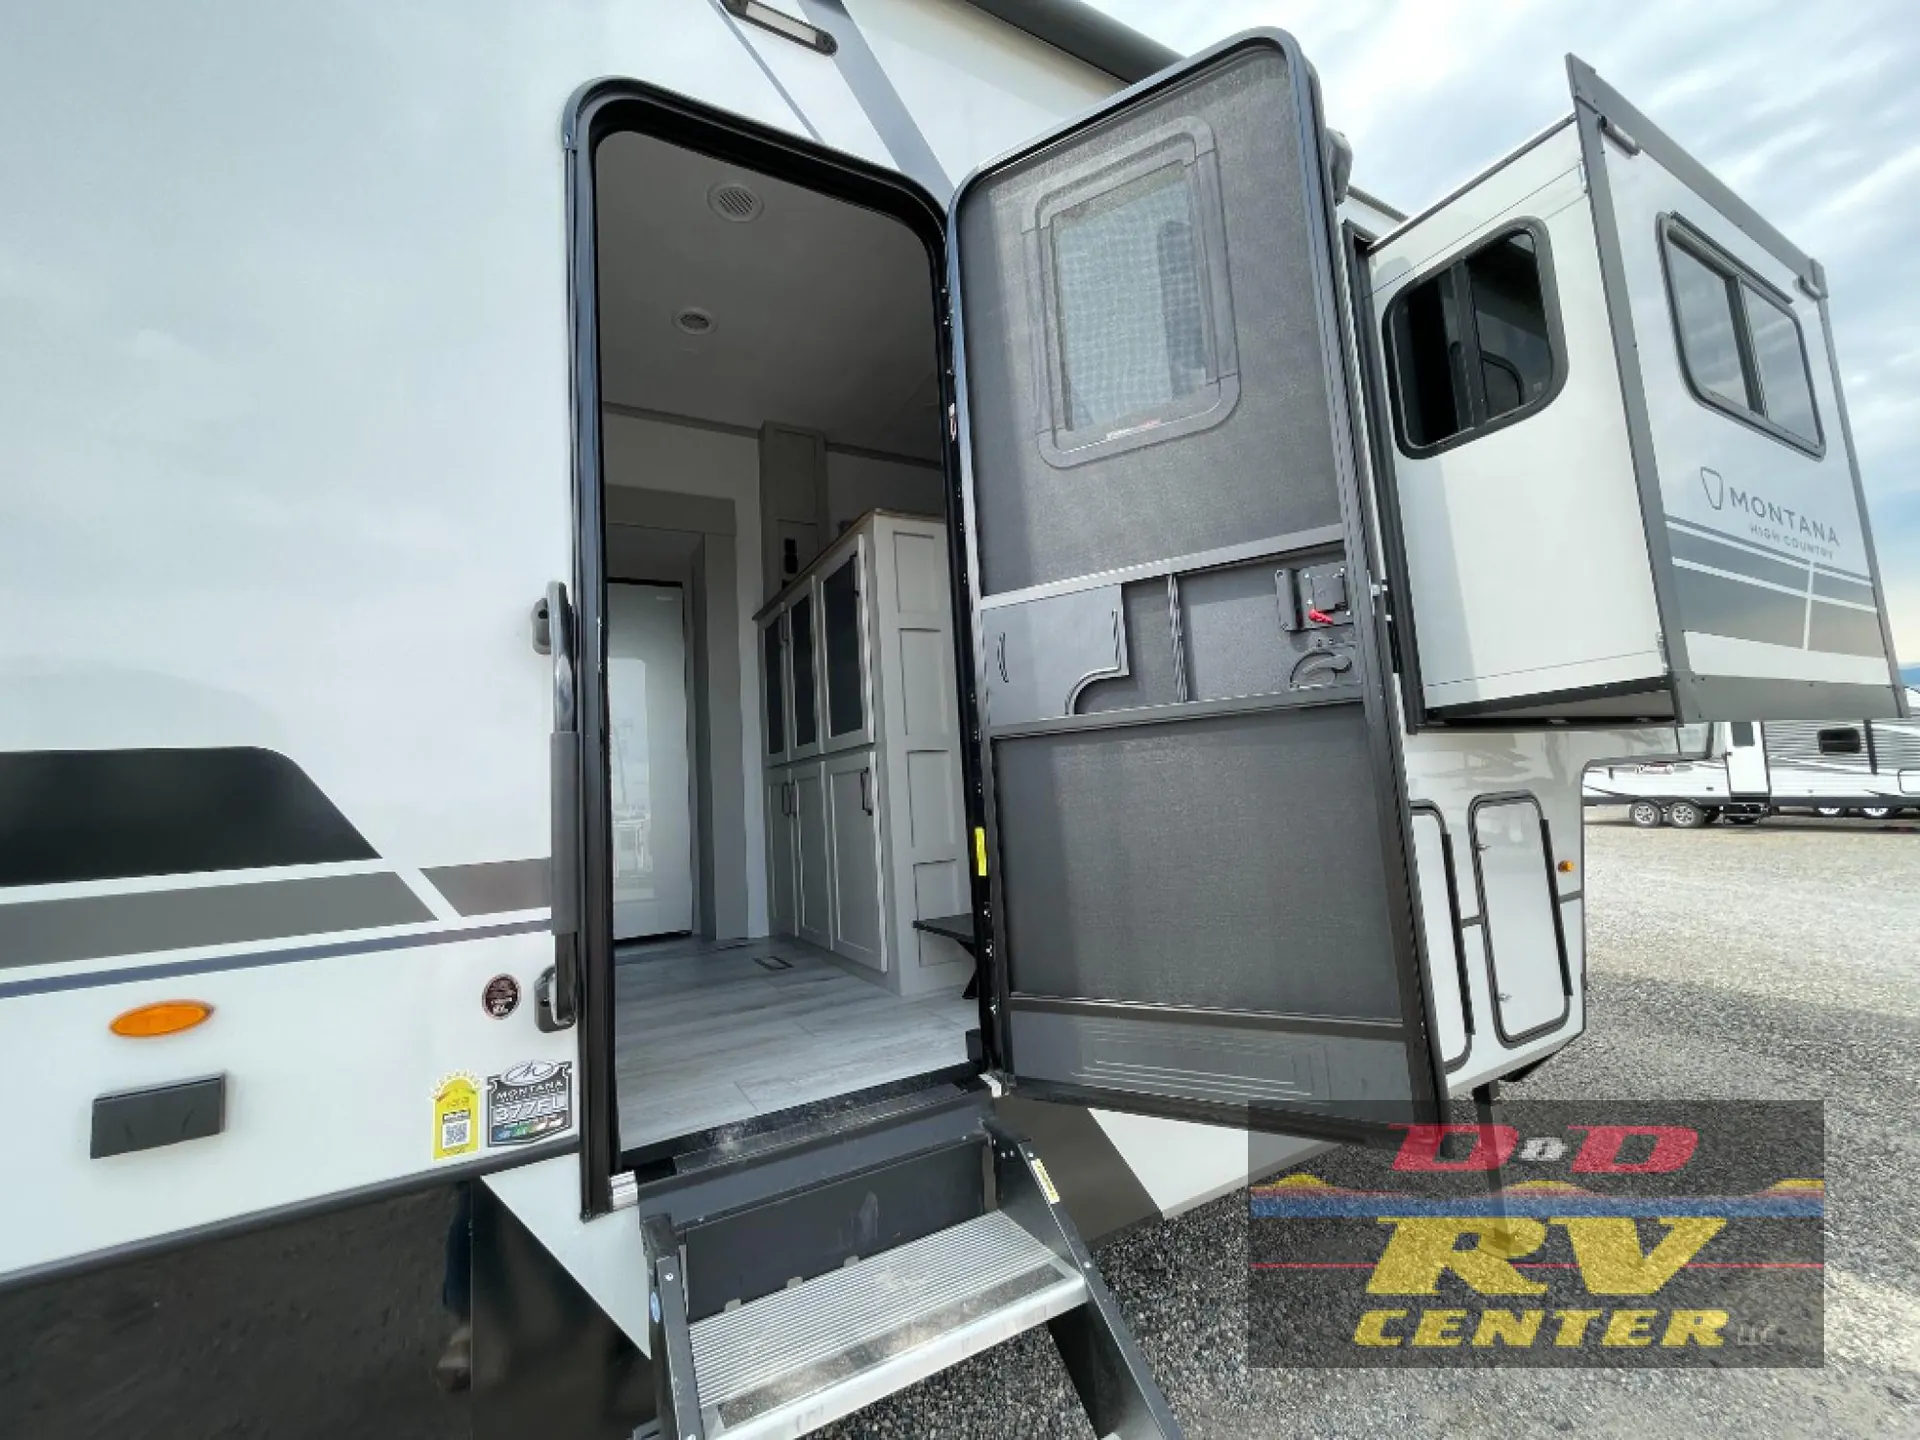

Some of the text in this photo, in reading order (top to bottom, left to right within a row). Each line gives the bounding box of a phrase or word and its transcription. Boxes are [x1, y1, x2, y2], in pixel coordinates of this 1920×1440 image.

[1729, 487, 1840, 547] MONTANA
[1750, 524, 1833, 559] HIGH COUNTRY
[496, 1080, 563, 1102] MONTANA
[495, 1096, 566, 1121] 377FL
